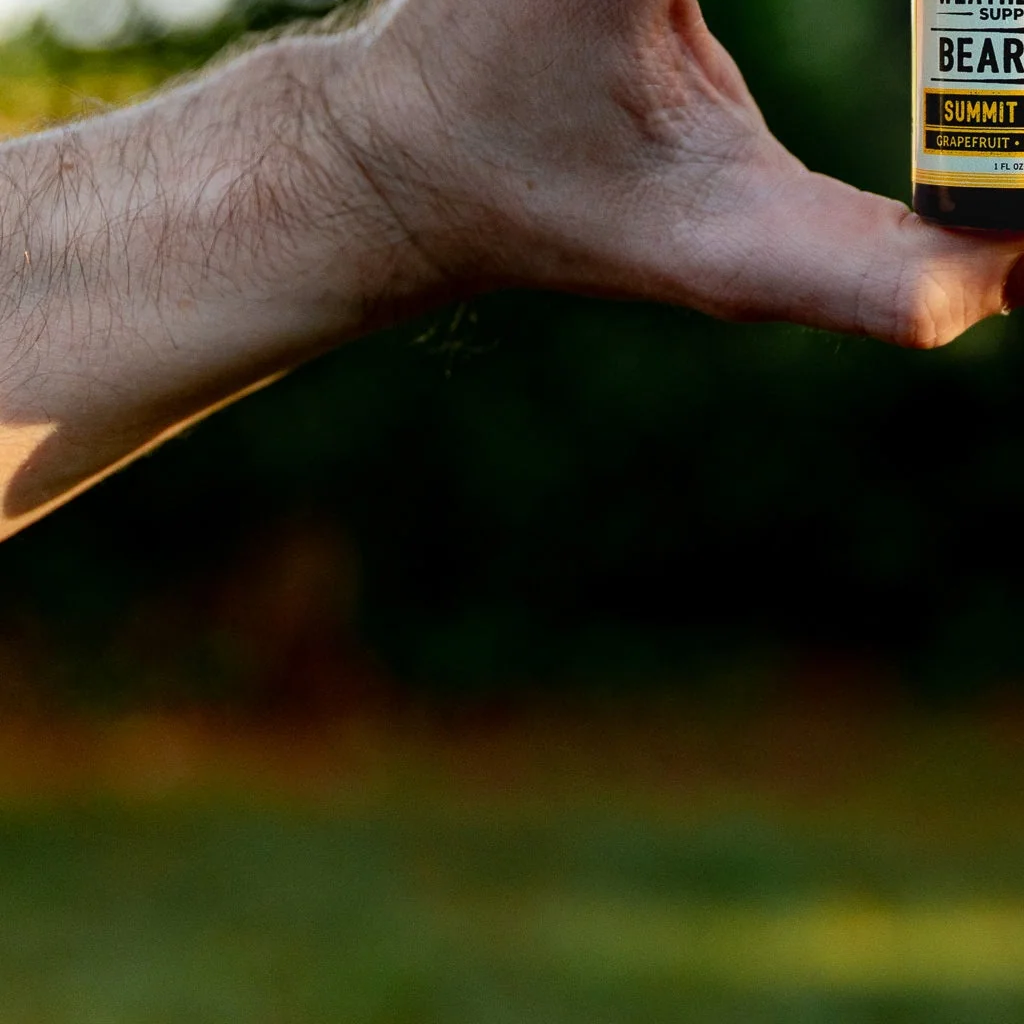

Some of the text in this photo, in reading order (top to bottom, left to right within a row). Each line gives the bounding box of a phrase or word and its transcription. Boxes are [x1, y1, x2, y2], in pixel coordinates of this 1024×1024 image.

[944, 100, 1018, 123] SUMMIT
[936, 135, 1010, 149] GRAPEFRUIT
[994, 163, 998, 171] 1
[1001, 163, 1010, 171] FL
[1013, 163, 1024, 171] OZ
